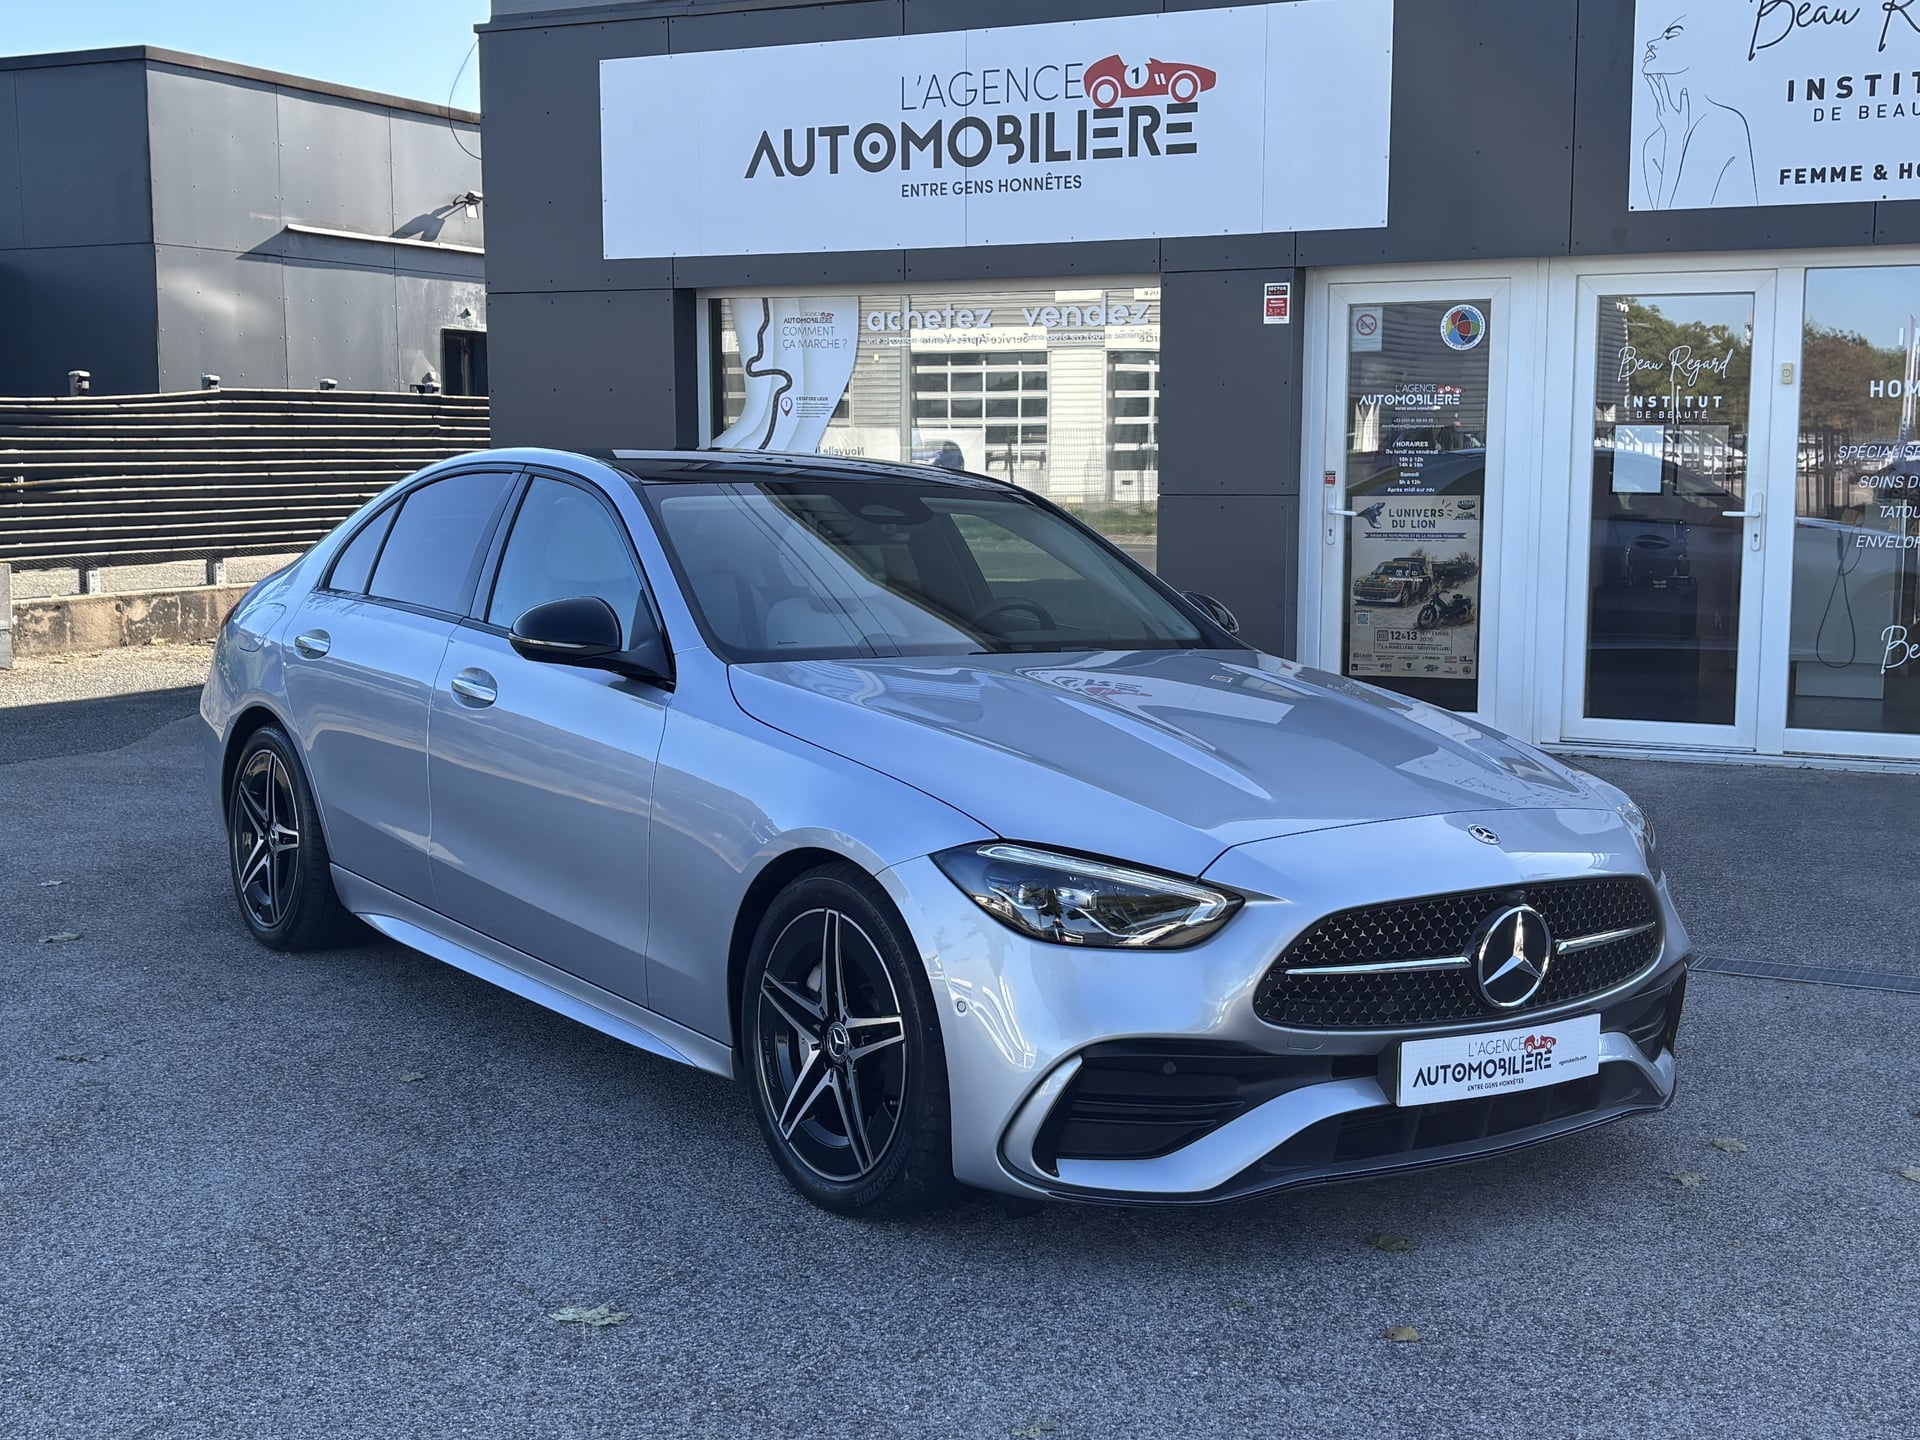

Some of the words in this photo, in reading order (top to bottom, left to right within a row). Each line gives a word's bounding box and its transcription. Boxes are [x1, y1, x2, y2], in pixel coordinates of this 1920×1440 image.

[1748, 0, 1860, 61] Beau
[1130, 68, 1141, 84] 1
[901, 63, 1083, 111] L'AGENCE
[1813, 107, 1842, 122] DE
[1779, 165, 1863, 185] FEMME
[1873, 164, 1888, 180] &
[901, 182, 948, 198] ENTRE
[952, 179, 994, 196] GENS
[998, 172, 1083, 193] HONNÊTES
[866, 302, 993, 331] achetez
[1022, 293, 1151, 328] vendez
[783, 326, 835, 336] COMMENT
[783, 339, 796, 350] ÇA
[798, 339, 840, 349] MARCHE
[1618, 346, 1663, 382] Beau
[1669, 345, 1733, 387] Regard
[1395, 383, 1437, 393] L'AGENCE
[1624, 396, 1723, 409] INSTITUT
[1636, 410, 1651, 419] DE
[1658, 408, 1708, 419] BEAUTÉ
[1859, 476, 1904, 489] SOINS
[1907, 475, 1920, 489] D
[1392, 520, 1406, 528] DU
[1411, 520, 1436, 529] LION
[1468, 1036, 1525, 1057] L'AGENCE
[1468, 1083, 1483, 1091] ENTRE
[1484, 1081, 1498, 1089] GENS
[1499, 1077, 1524, 1086] HONNÊTES
